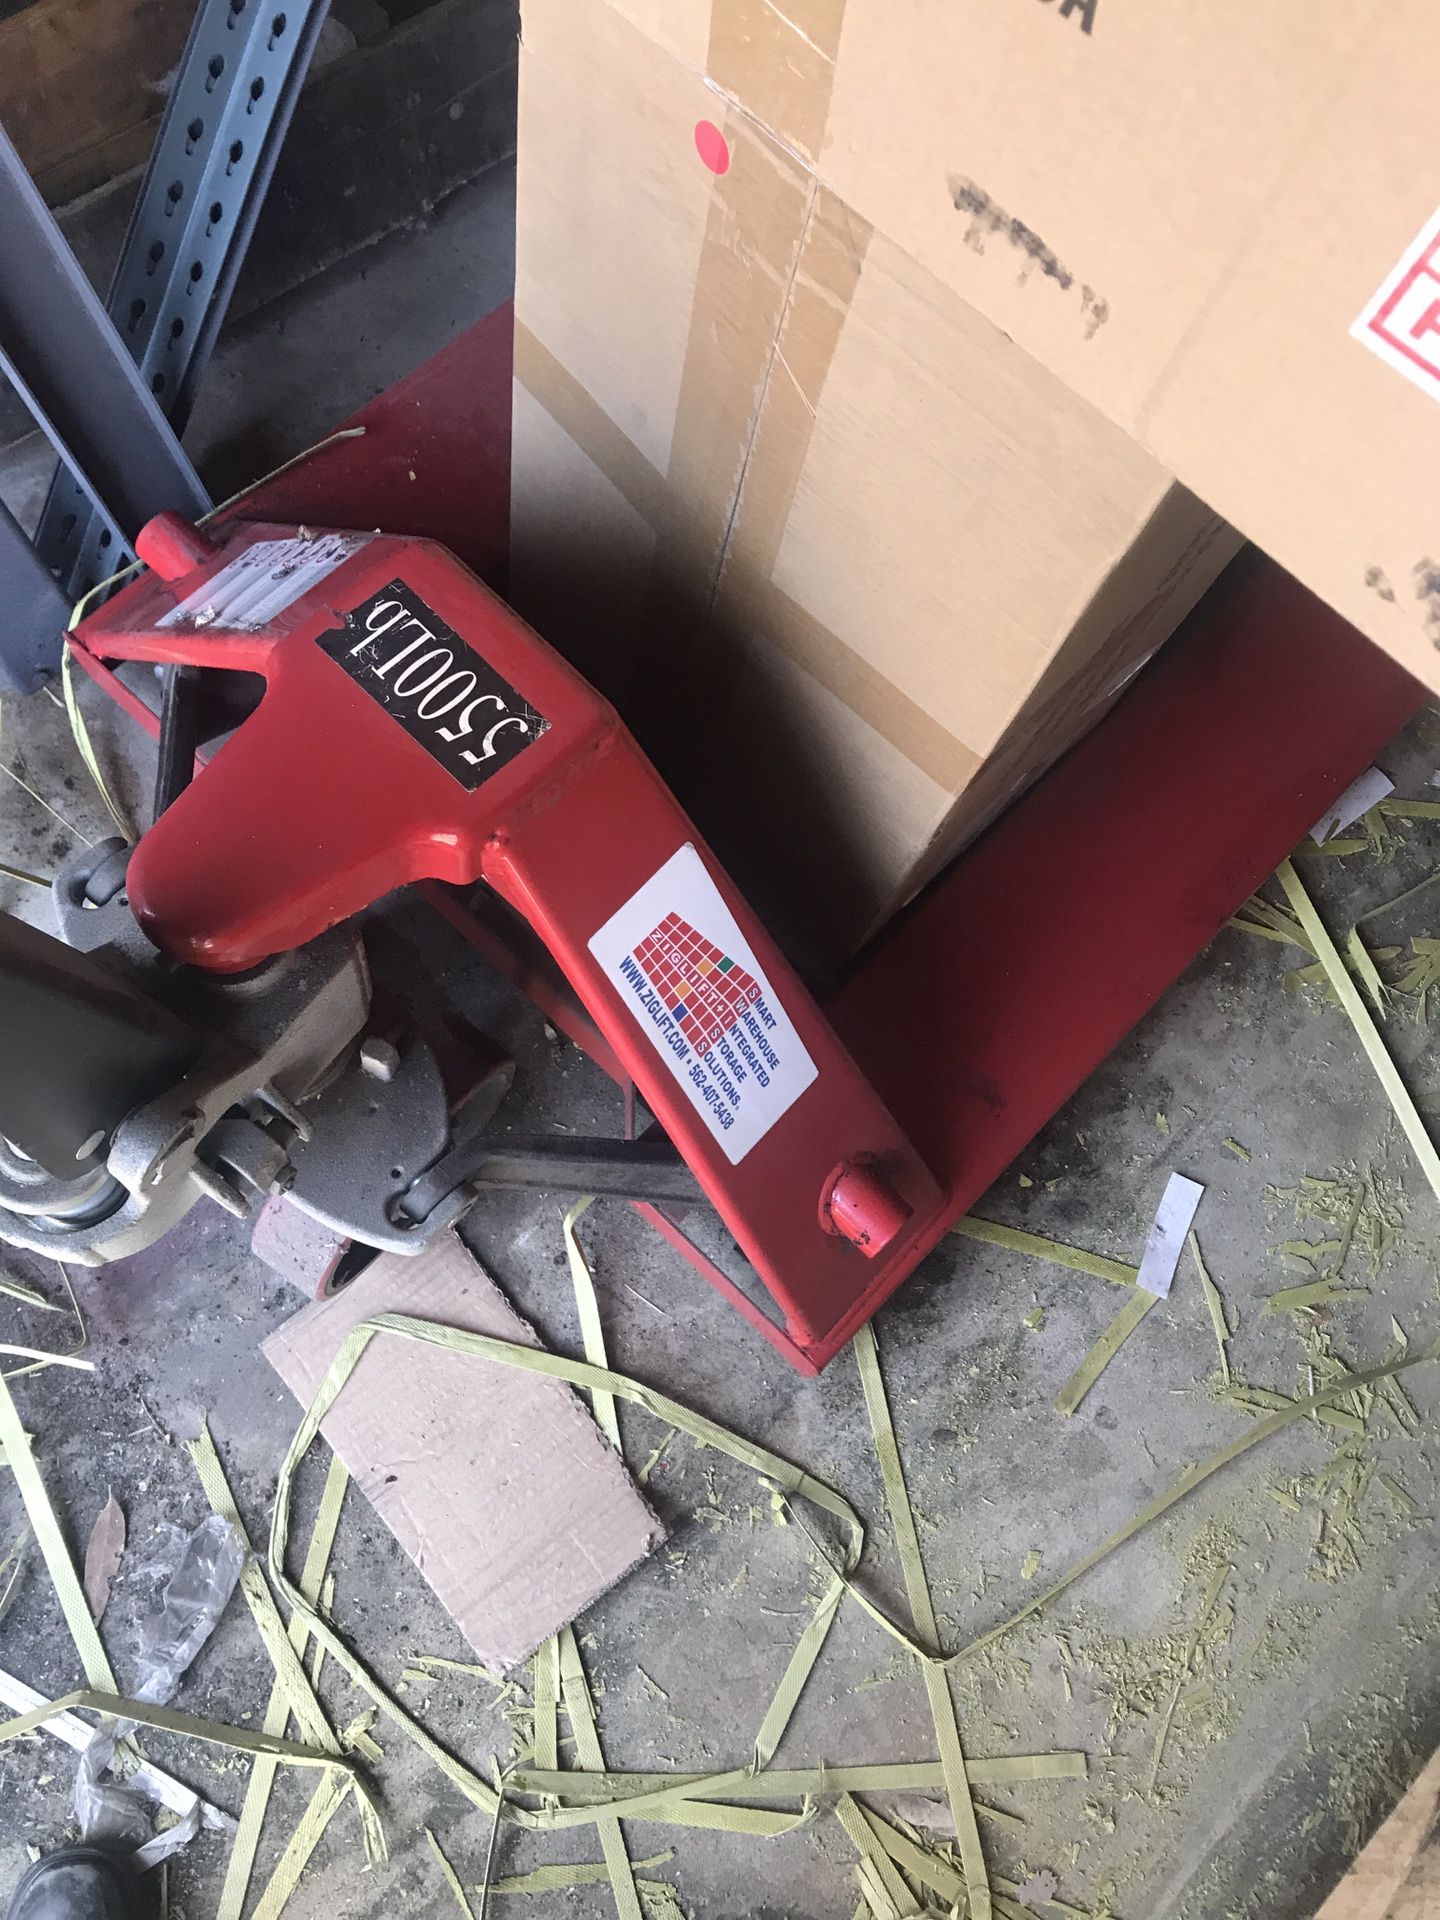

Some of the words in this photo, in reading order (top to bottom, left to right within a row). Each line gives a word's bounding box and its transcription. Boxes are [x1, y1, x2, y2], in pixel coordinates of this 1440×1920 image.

[350, 599, 529, 766] 5500Lb
[619, 955, 690, 1060] WWW.ZIGLIFT.COM
[688, 1063, 735, 1130] 562-407-5438
[735, 998, 780, 1070] WAREHOUSE
[749, 987, 777, 1030] SMART
[710, 1027, 748, 1083] STORAGE
[724, 1015, 770, 1088] INTEGRATED
